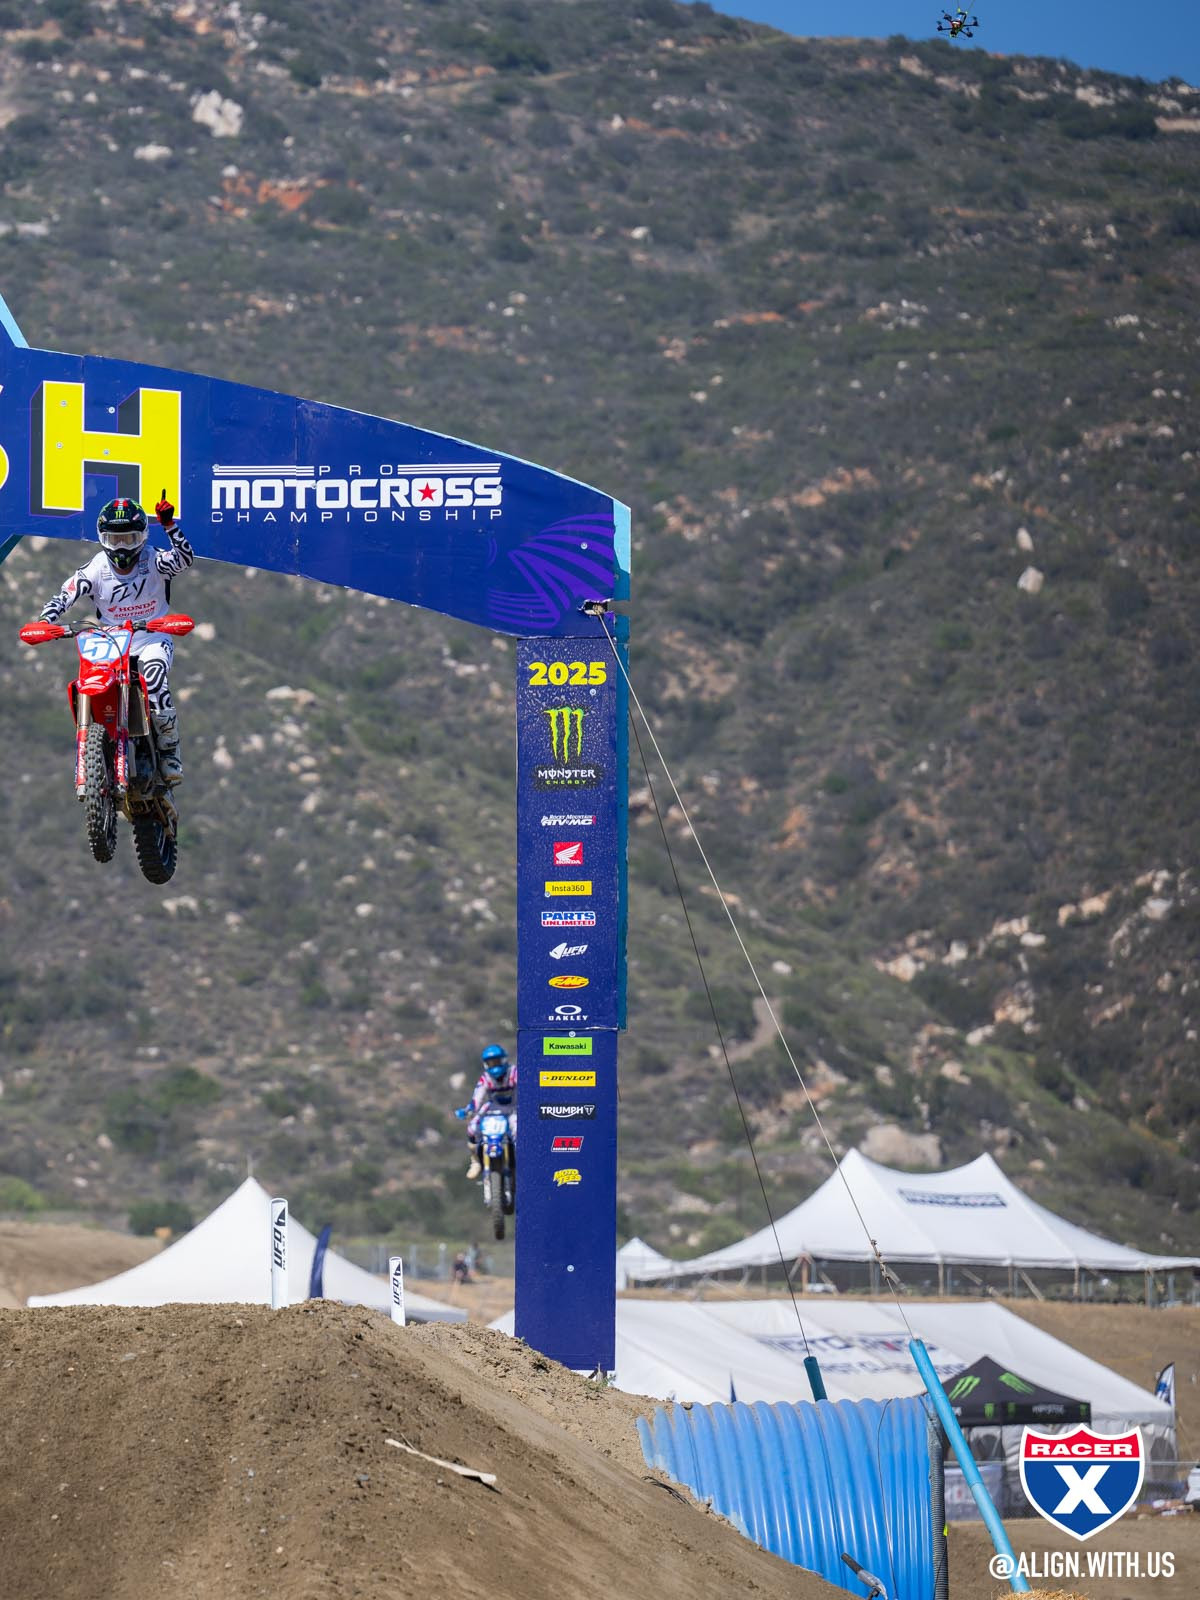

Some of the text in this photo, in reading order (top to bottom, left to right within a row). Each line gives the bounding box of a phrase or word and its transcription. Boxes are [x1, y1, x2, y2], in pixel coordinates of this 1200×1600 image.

[318, 464, 394, 476] PRO
[211, 477, 502, 509] MOTOCROSS
[211, 509, 503, 523] CHAMPIONSHIP
[110, 579, 147, 604] FLY
[119, 600, 156, 612] HONDA
[528, 662, 607, 686] 2025
[538, 768, 596, 779] MONSTER
[551, 884, 585, 892] Insta360
[542, 912, 594, 920] PARTS
[563, 945, 588, 954] UFO
[540, 1106, 584, 1117] TRIUMPH
[274, 1227, 282, 1268] UFO
[393, 1278, 401, 1305] UFO
